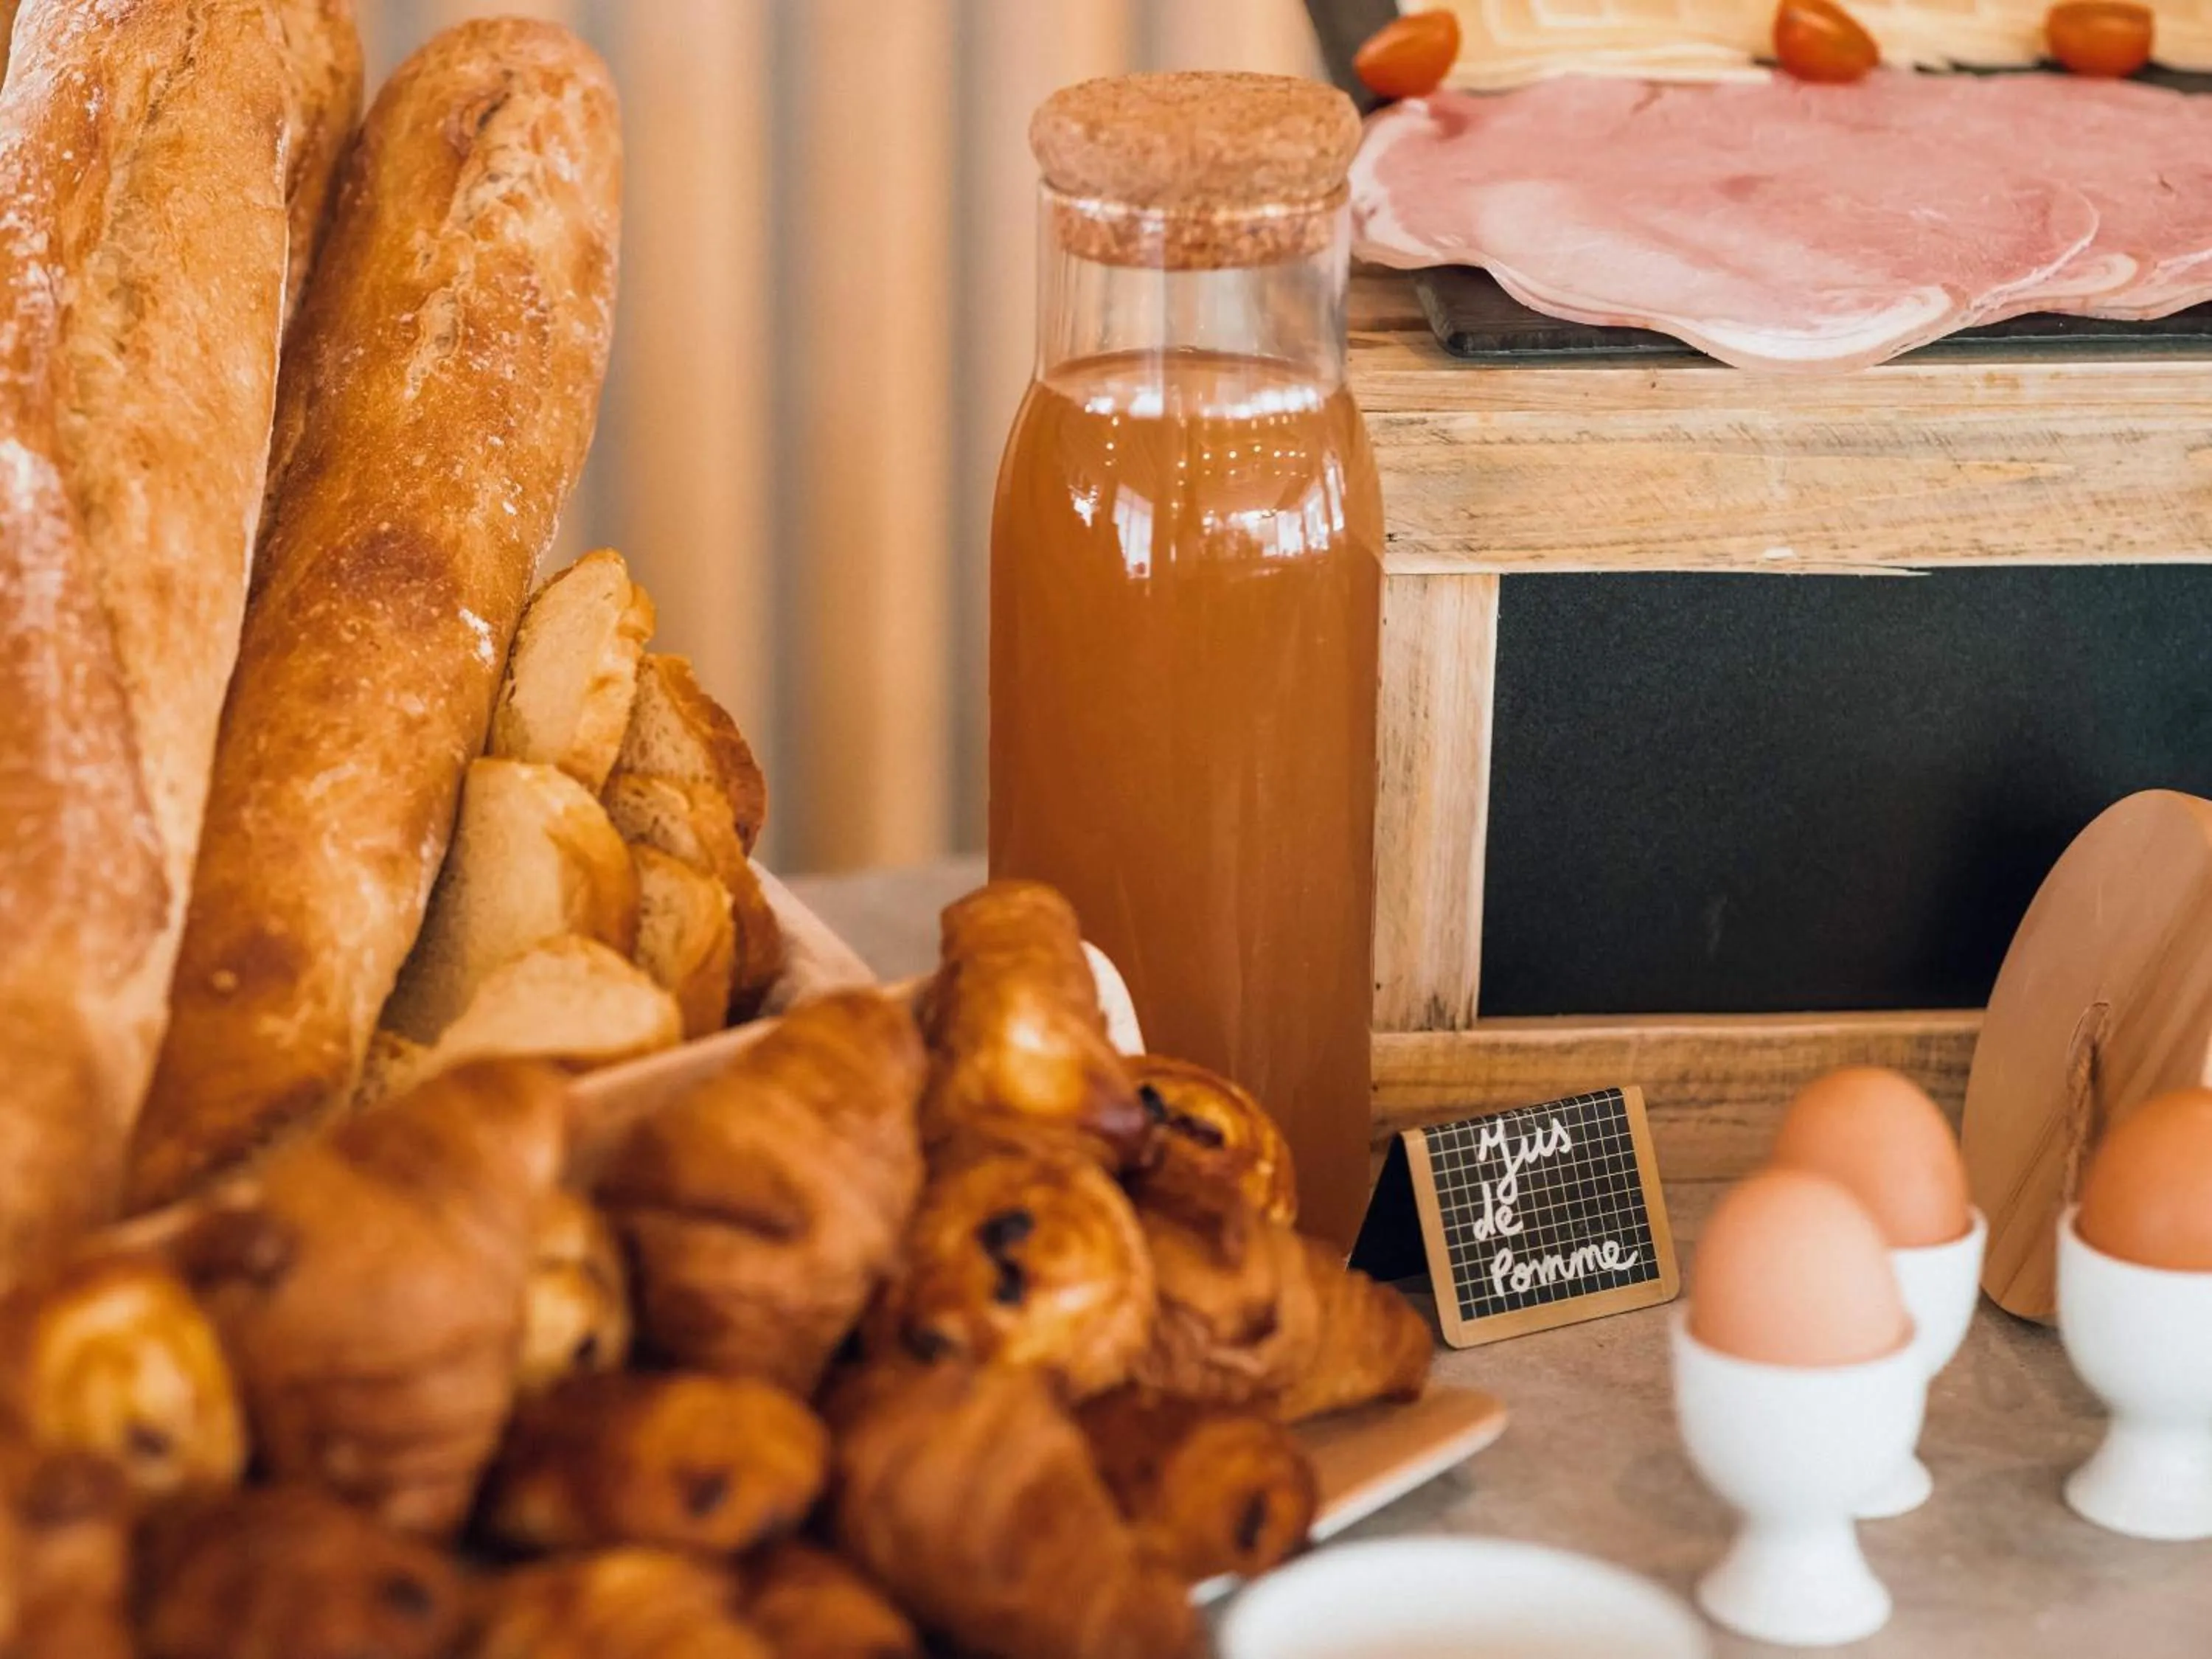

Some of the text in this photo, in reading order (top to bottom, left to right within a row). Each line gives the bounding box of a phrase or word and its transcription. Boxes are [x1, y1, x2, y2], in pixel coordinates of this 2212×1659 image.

[1478, 1118, 1571, 1206] Jus
[1473, 1182, 1523, 1242] de
[1490, 1239, 1638, 1297] Pomme
